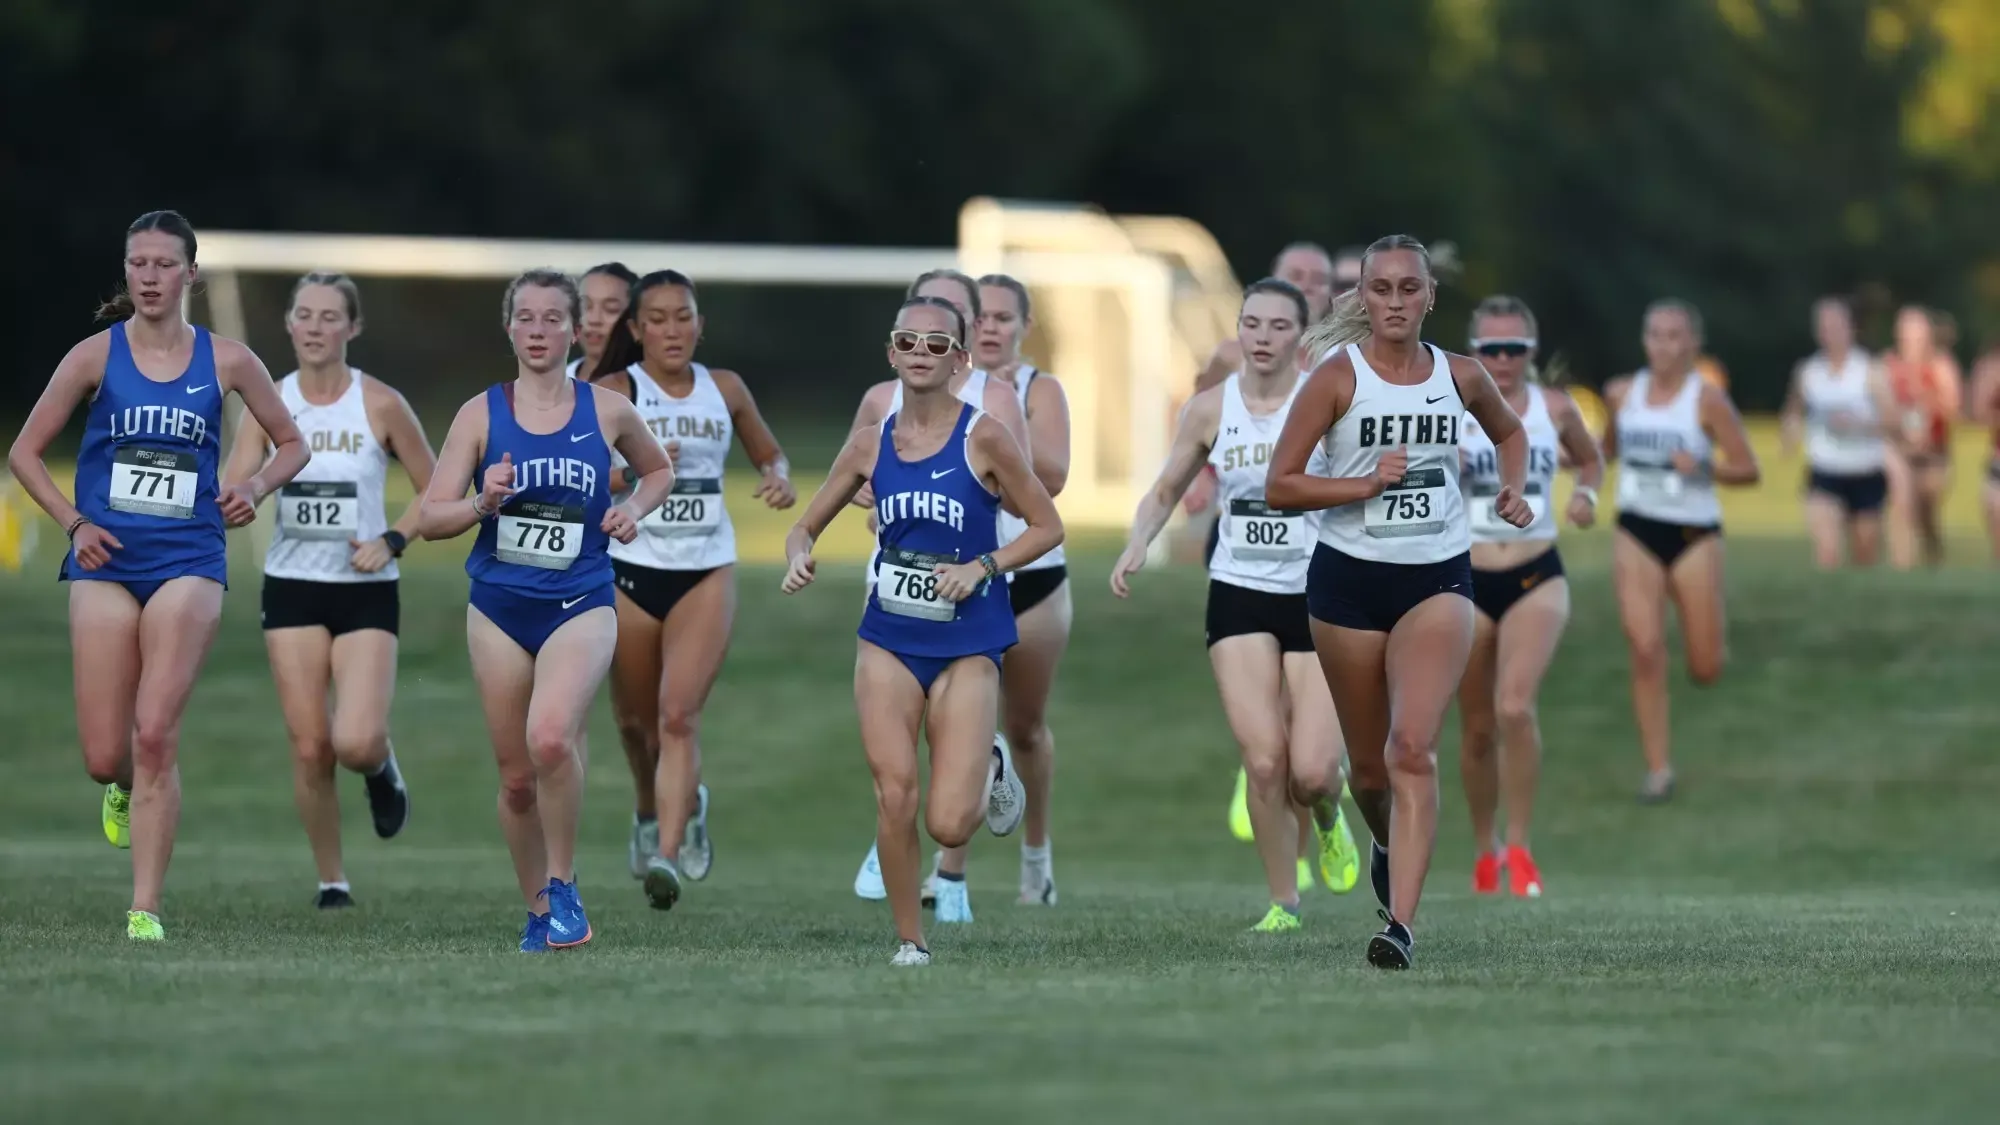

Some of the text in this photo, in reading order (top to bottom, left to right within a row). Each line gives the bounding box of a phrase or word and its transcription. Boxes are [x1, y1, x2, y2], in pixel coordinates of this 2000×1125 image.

[110, 405, 206, 446] LUTHER
[677, 415, 725, 441] OLAF
[1359, 414, 1458, 448] BETHEL
[312, 429, 364, 455] OLAF
[1224, 444, 1250, 472] ST.
[130, 469, 176, 500] 771
[502, 457, 596, 498] UTHER
[296, 501, 341, 526] 812
[661, 499, 705, 522] 820
[1382, 493, 1430, 520] 753
[516, 522, 565, 553] 778
[1246, 521, 1289, 545] 802
[893, 570, 939, 603] 768
